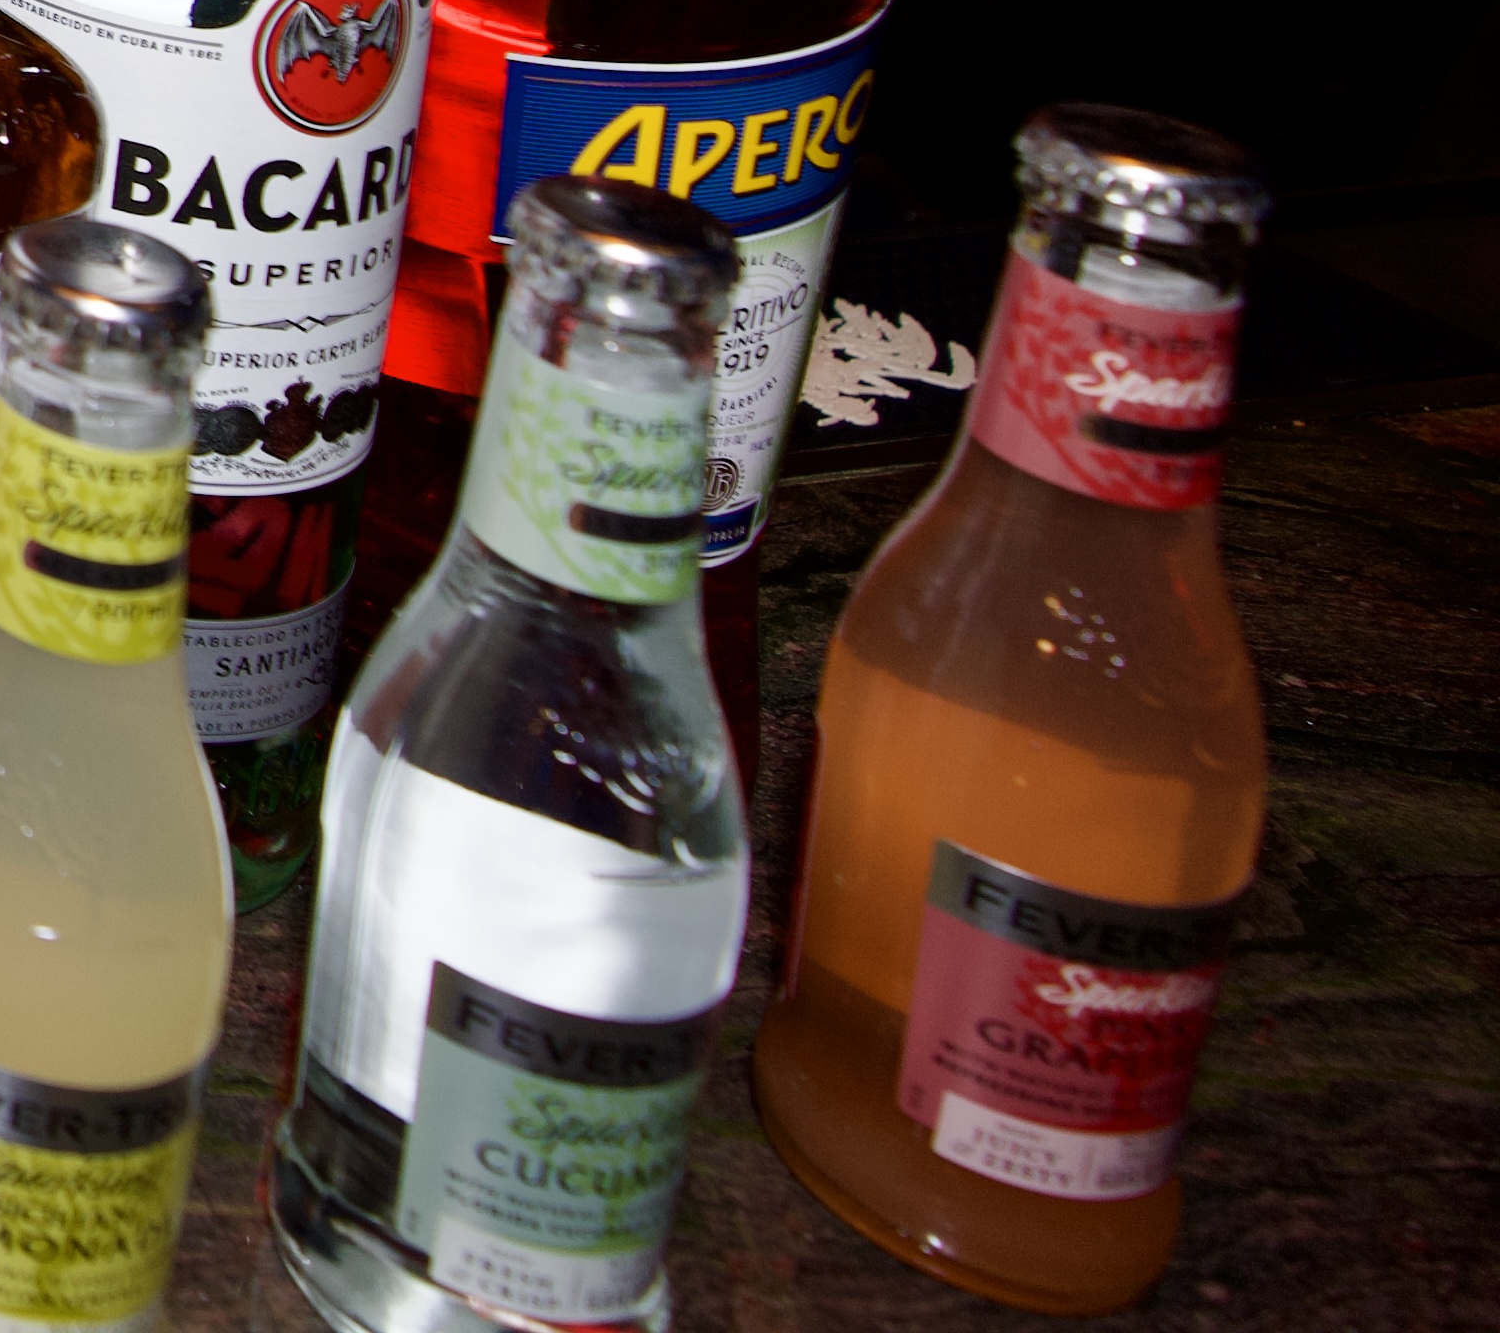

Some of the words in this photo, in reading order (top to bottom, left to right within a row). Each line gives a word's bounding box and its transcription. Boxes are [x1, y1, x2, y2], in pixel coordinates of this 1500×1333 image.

[97, 27, 115, 41] EN
[120, 33, 159, 52] CUBA
[164, 43, 184, 56] EN
[188, 48, 224, 62] 1862
[196, 238, 395, 288] SUPERIOR
[731, 282, 809, 334] RITIVO
[306, 340, 358, 367] CARTA
[723, 329, 766, 353] SINCE
[182, 630, 287, 649] TABLECIDO
